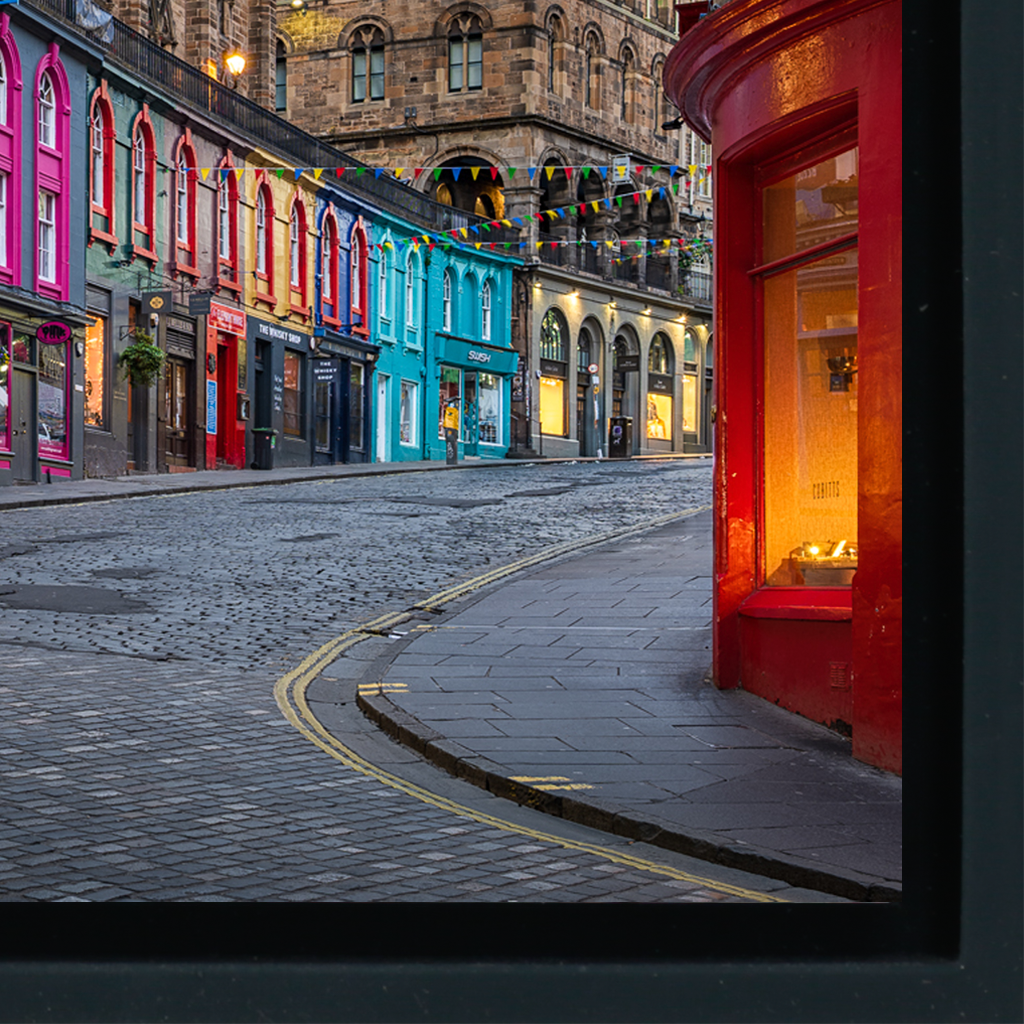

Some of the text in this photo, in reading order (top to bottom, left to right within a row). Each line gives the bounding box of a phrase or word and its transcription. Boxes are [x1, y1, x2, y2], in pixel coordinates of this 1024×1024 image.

[259, 324, 301, 344] THE WHISKY SHOP
